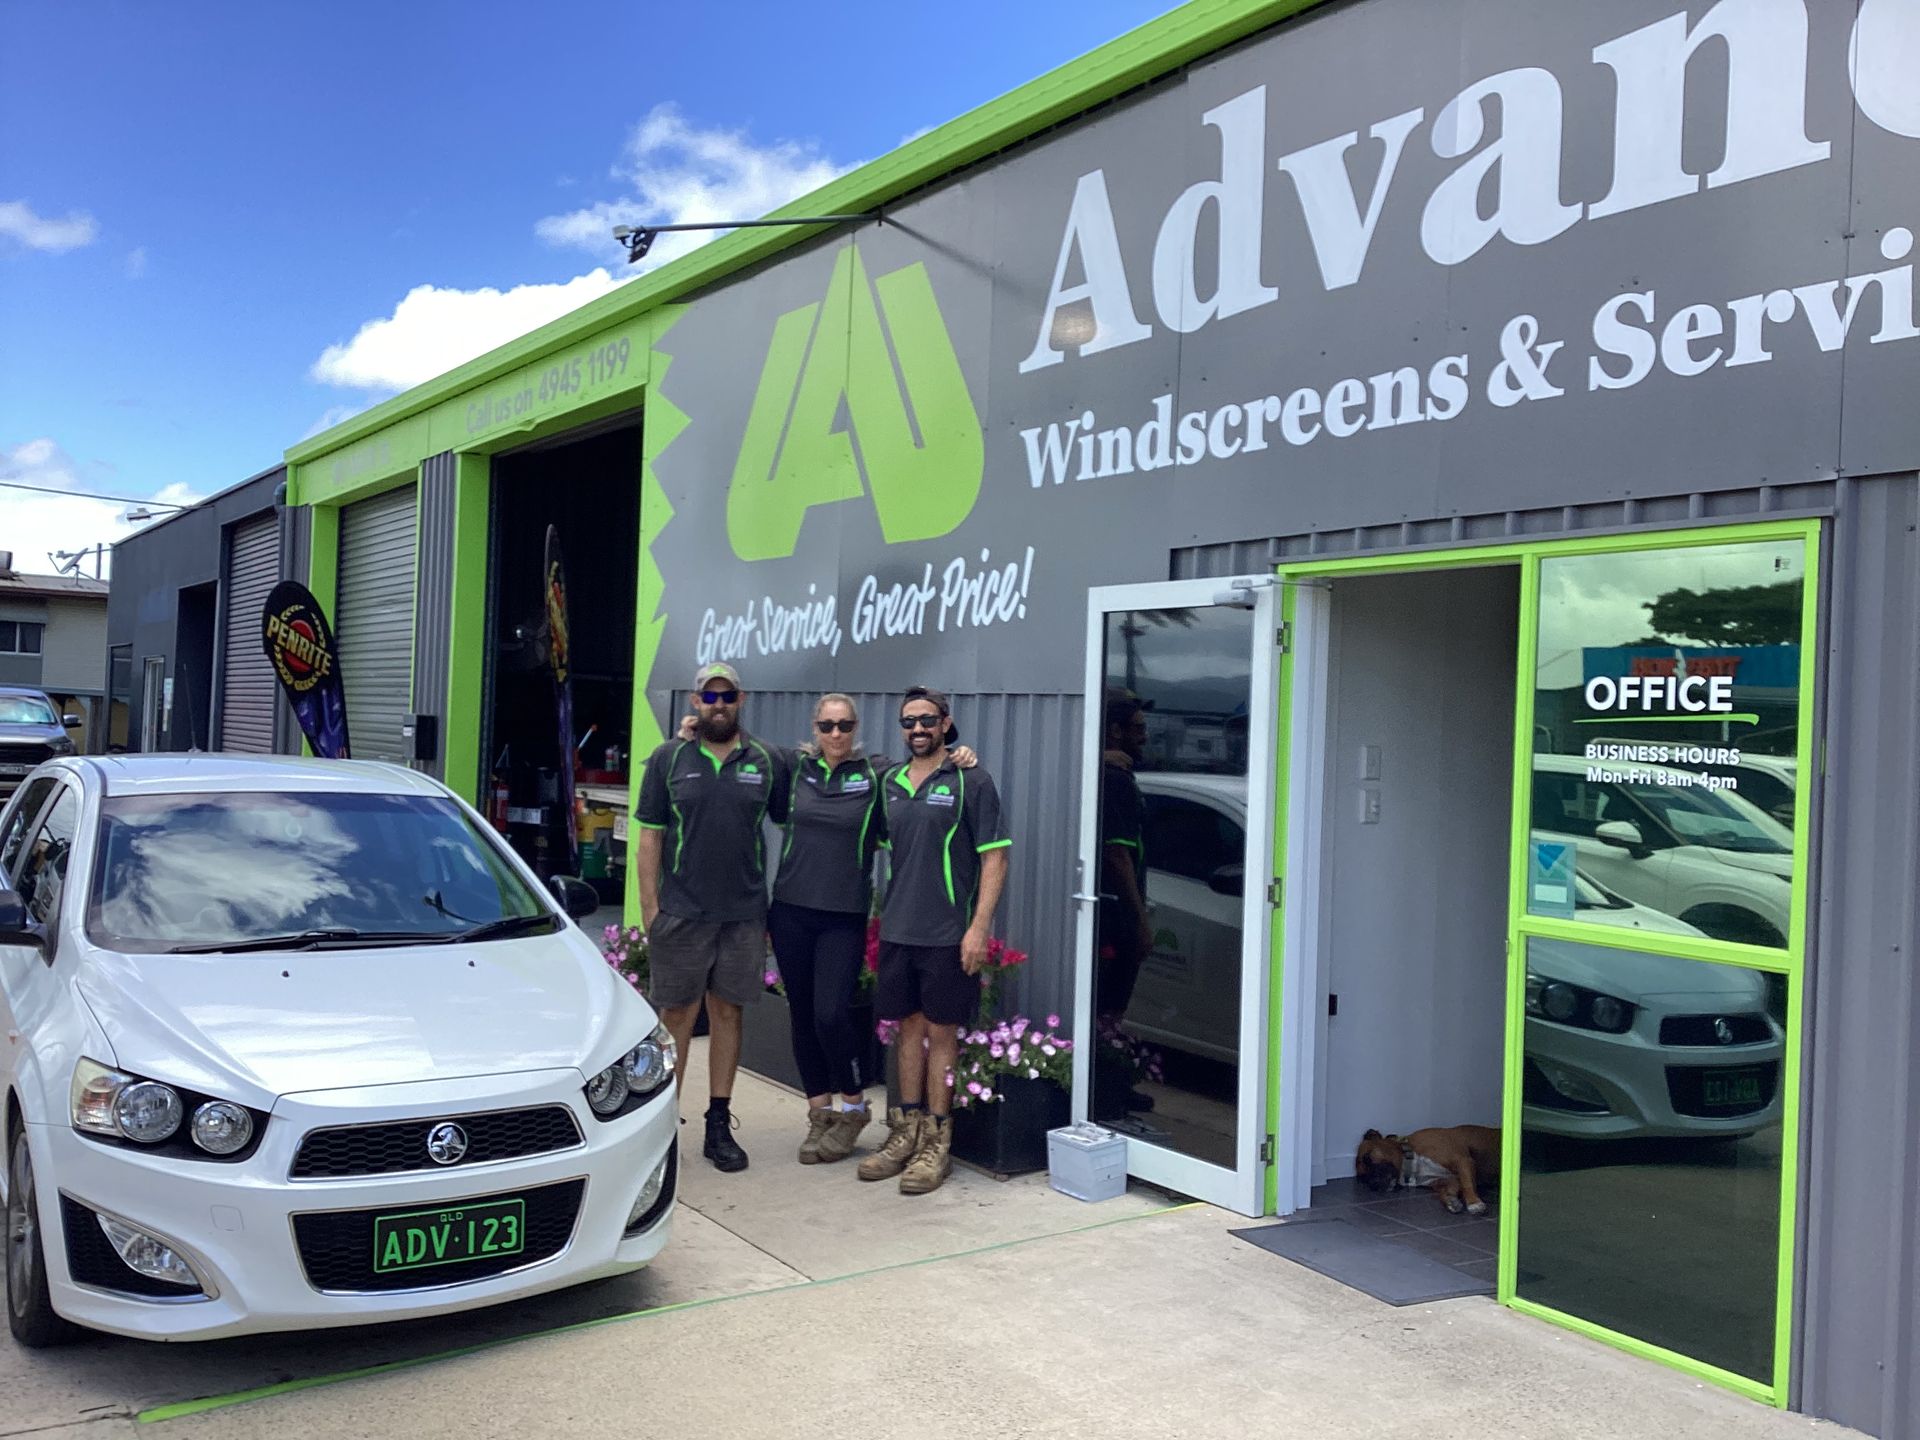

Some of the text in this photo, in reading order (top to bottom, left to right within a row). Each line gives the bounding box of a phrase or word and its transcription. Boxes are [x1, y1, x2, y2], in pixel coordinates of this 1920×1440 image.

[1019, 226, 1920, 489] Windscreens & Servi
[466, 336, 631, 434] Call us on 4945 1199
[696, 546, 1035, 666] Great Service, Great Price!
[266, 614, 333, 676] PENRITE
[1585, 675, 1734, 712] OFFICE
[1585, 743, 1741, 766] BUSINESS HOURS
[1586, 766, 1738, 793] Mon-Fri 8am-4pm
[440, 1211, 464, 1223] QLD
